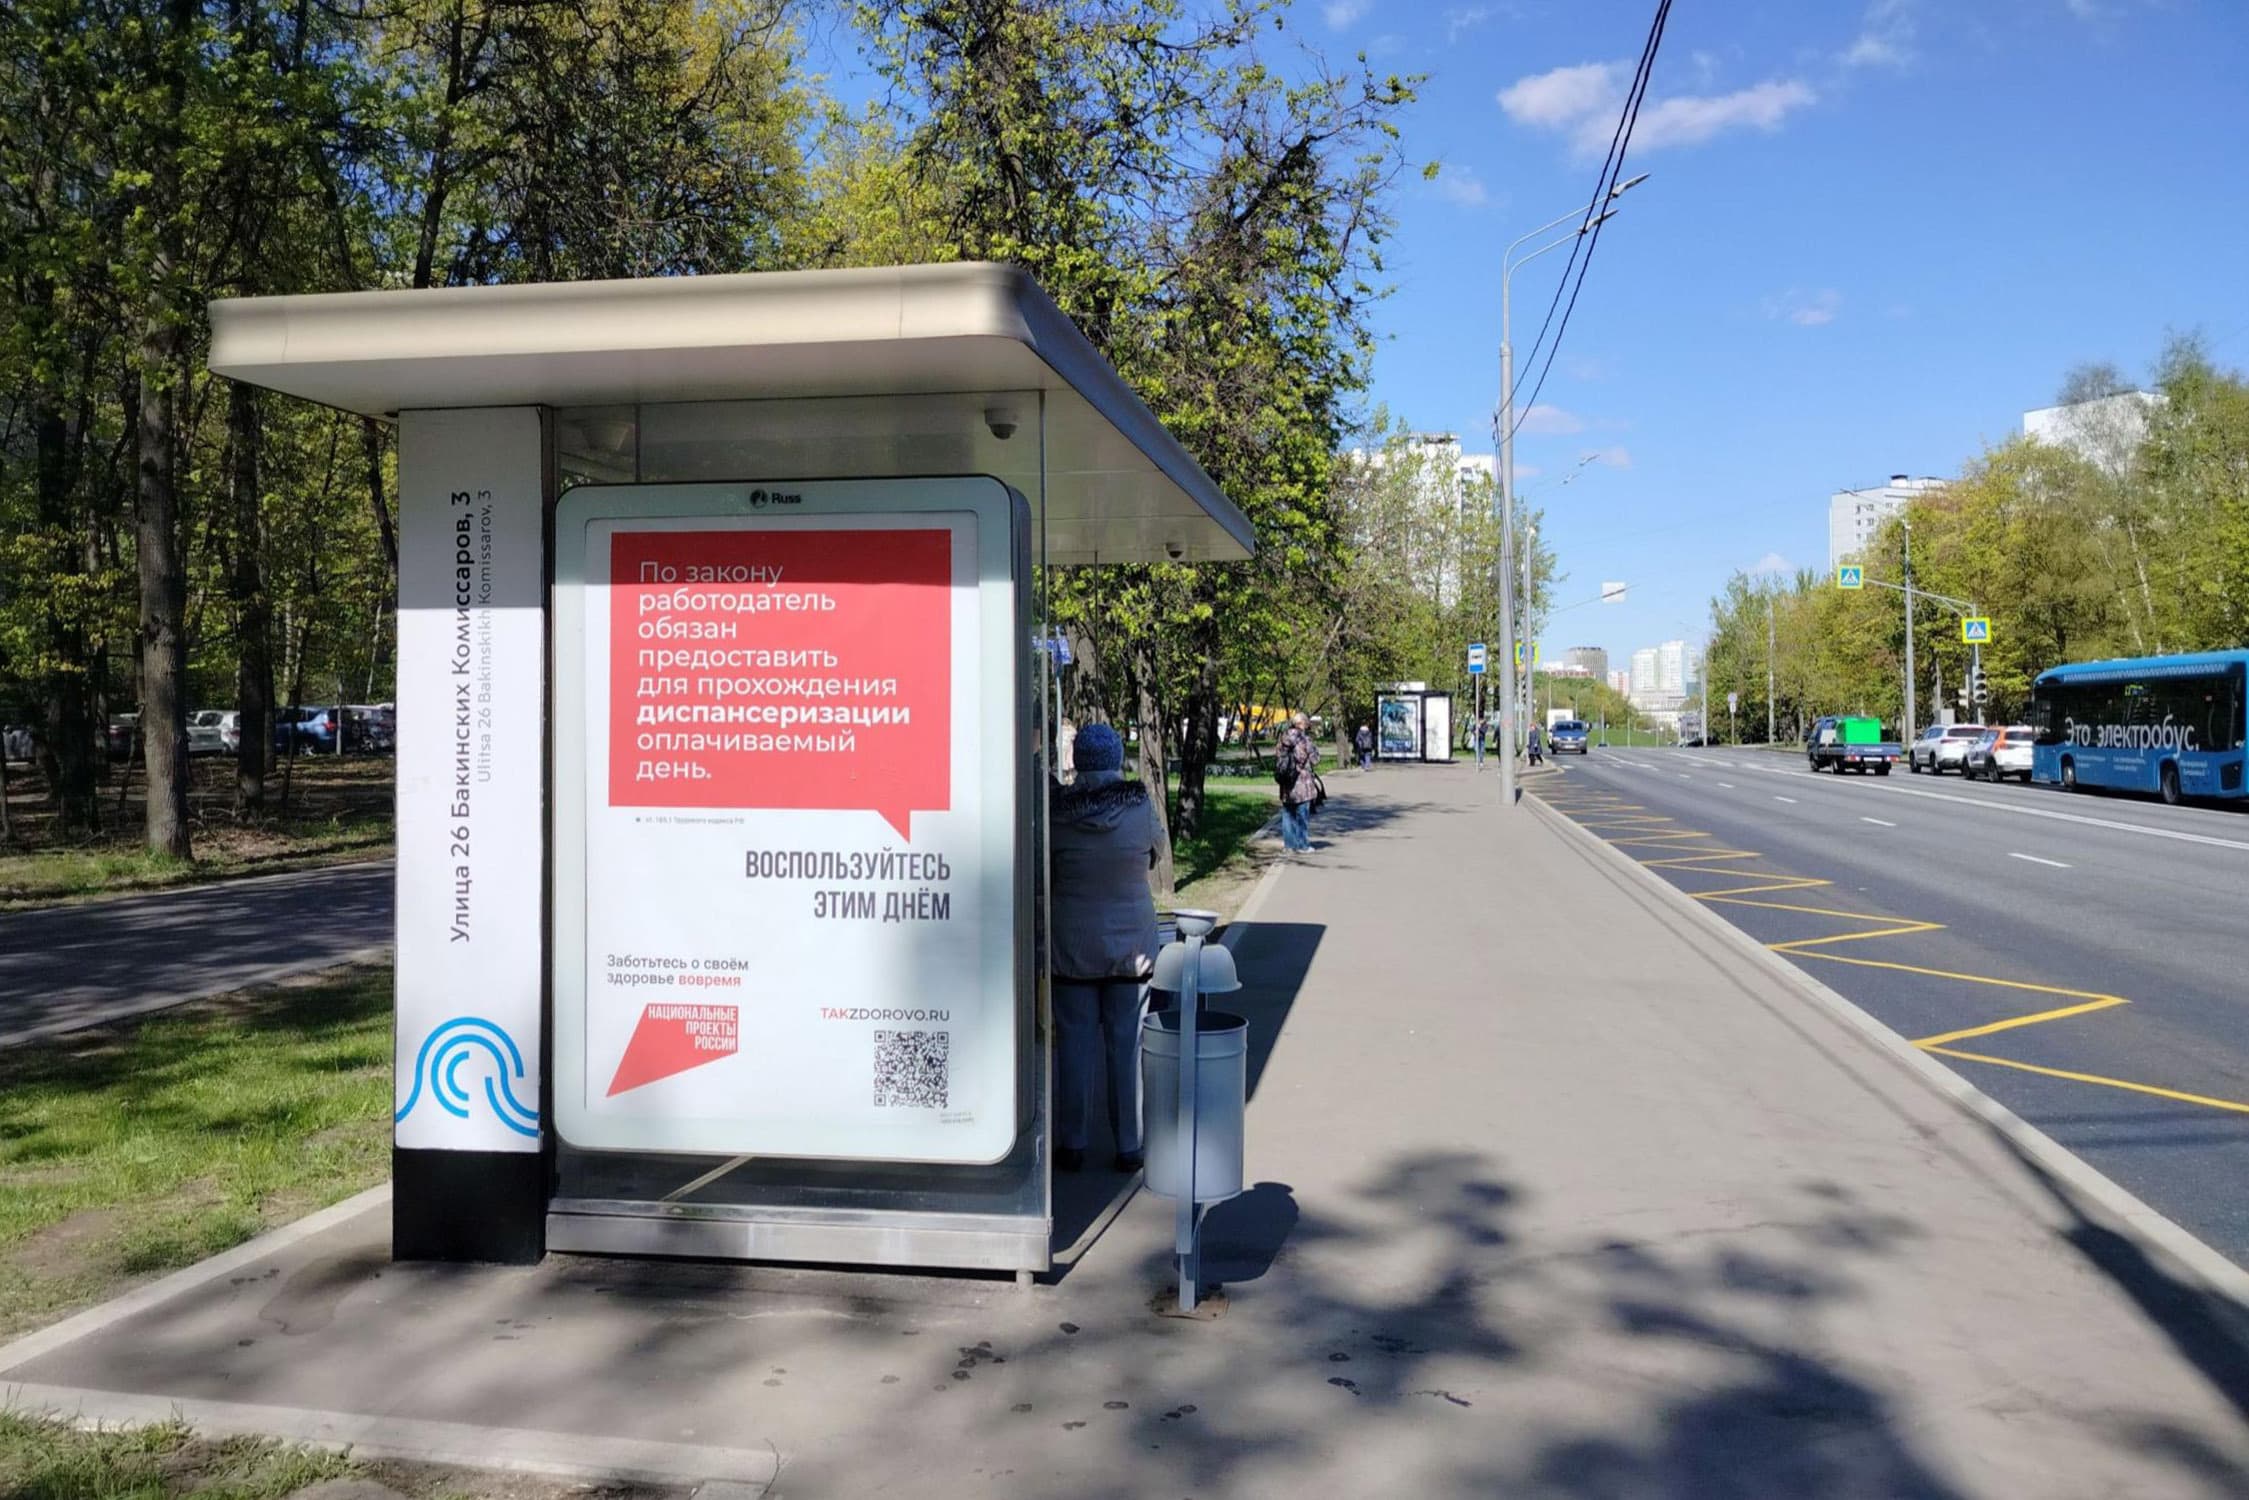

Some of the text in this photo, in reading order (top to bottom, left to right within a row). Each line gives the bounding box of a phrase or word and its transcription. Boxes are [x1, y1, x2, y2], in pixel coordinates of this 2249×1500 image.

[640, 561, 783, 588] По закону
[638, 588, 836, 616] работодатель
[477, 489, 493, 783] Ulitsa 26 Bakinskikh Komissarov, 3
[638, 615, 736, 640] обязан
[639, 648, 838, 673] предоставить
[636, 675, 897, 700] для прохождения
[450, 491, 475, 942] Улица 26 Бакинских Комиссаров, 3
[636, 704, 910, 728] диспансеризации
[637, 729, 855, 752] оплачиваемый
[2064, 714, 2199, 758] Это электробус.
[636, 760, 712, 781] день.
[746, 846, 950, 881] ВОСПОЛЬЗУЙТЕСЬ
[814, 888, 950, 923] ЭТИМ ДНЁМ
[608, 954, 749, 971] Заботьтесь о своём
[607, 972, 741, 988] здоровье вовремя
[648, 1006, 736, 1022] НАЦИОНАЛЬНЫЕ
[820, 1006, 950, 1022] TAKZDOROVO.RU
[685, 1021, 736, 1036] ПРОЕКТЫ
[695, 1036, 736, 1051] РОССИИ
